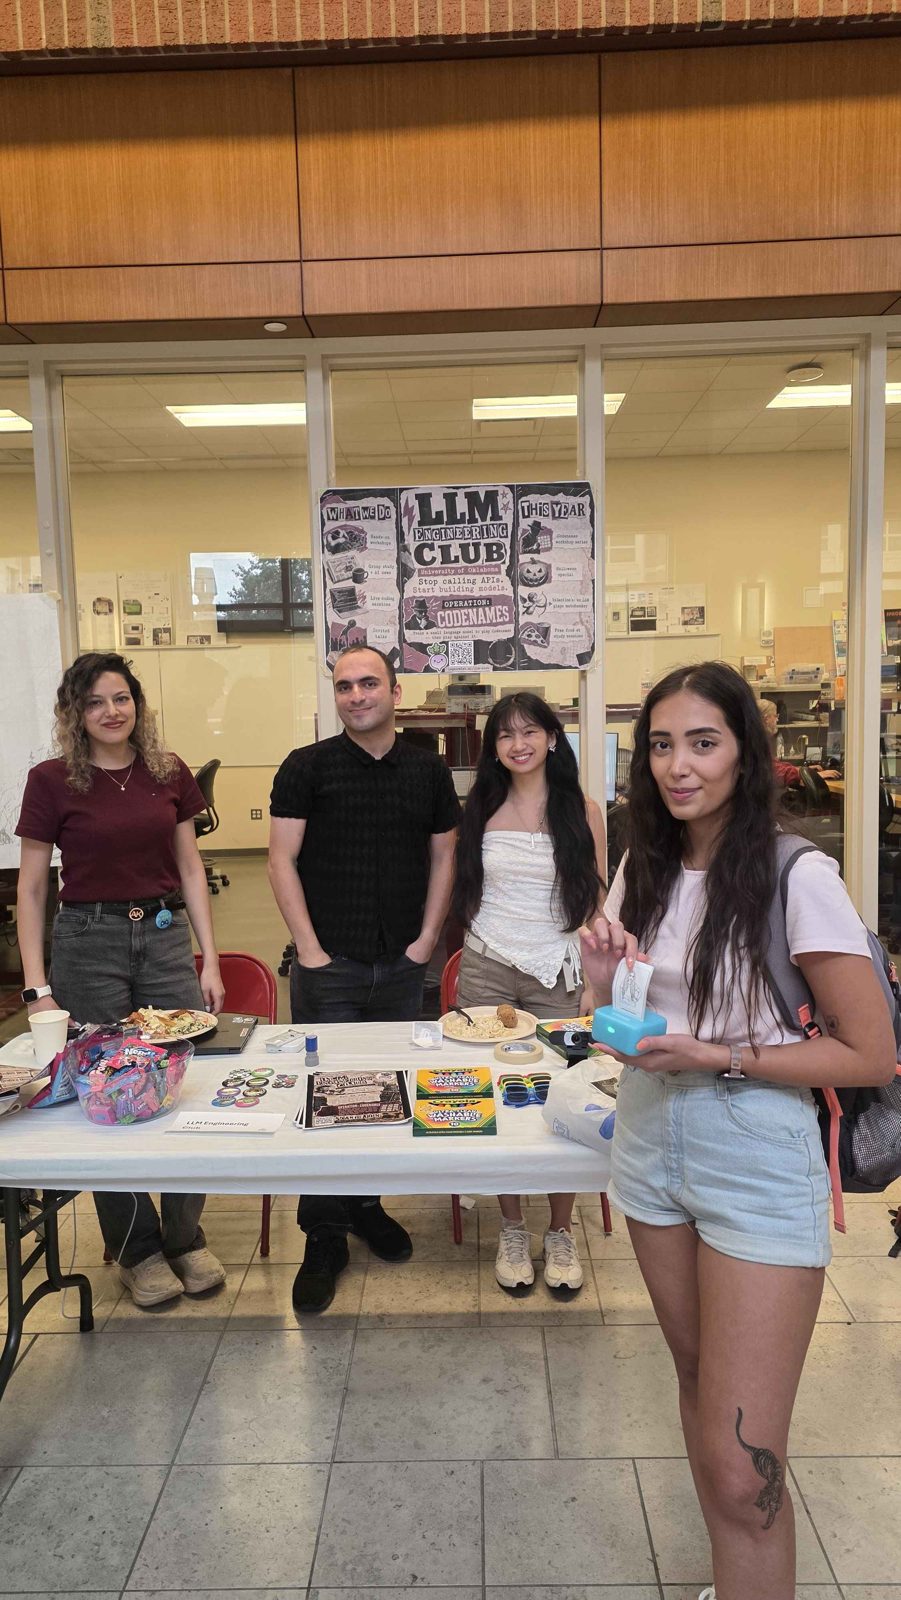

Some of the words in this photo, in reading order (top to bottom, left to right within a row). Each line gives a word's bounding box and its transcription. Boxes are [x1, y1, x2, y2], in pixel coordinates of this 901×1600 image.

[327, 507, 360, 520] WHAT
[362, 507, 375, 520] WE
[378, 505, 391, 519] DO
[415, 489, 503, 527] LLM
[551, 502, 586, 519] YEAR
[413, 523, 508, 542] ENGINEERING
[414, 541, 506, 566] CLUB
[418, 578, 438, 586] Stop
[442, 577, 477, 585] calling
[480, 576, 504, 584] APIs.
[439, 585, 475, 593] building
[444, 600, 490, 608] OPERATION:
[437, 605, 510, 628] CODENAMES
[428, 1077, 480, 1085] WASHABLE
[427, 1111, 482, 1119] WASHABLE
